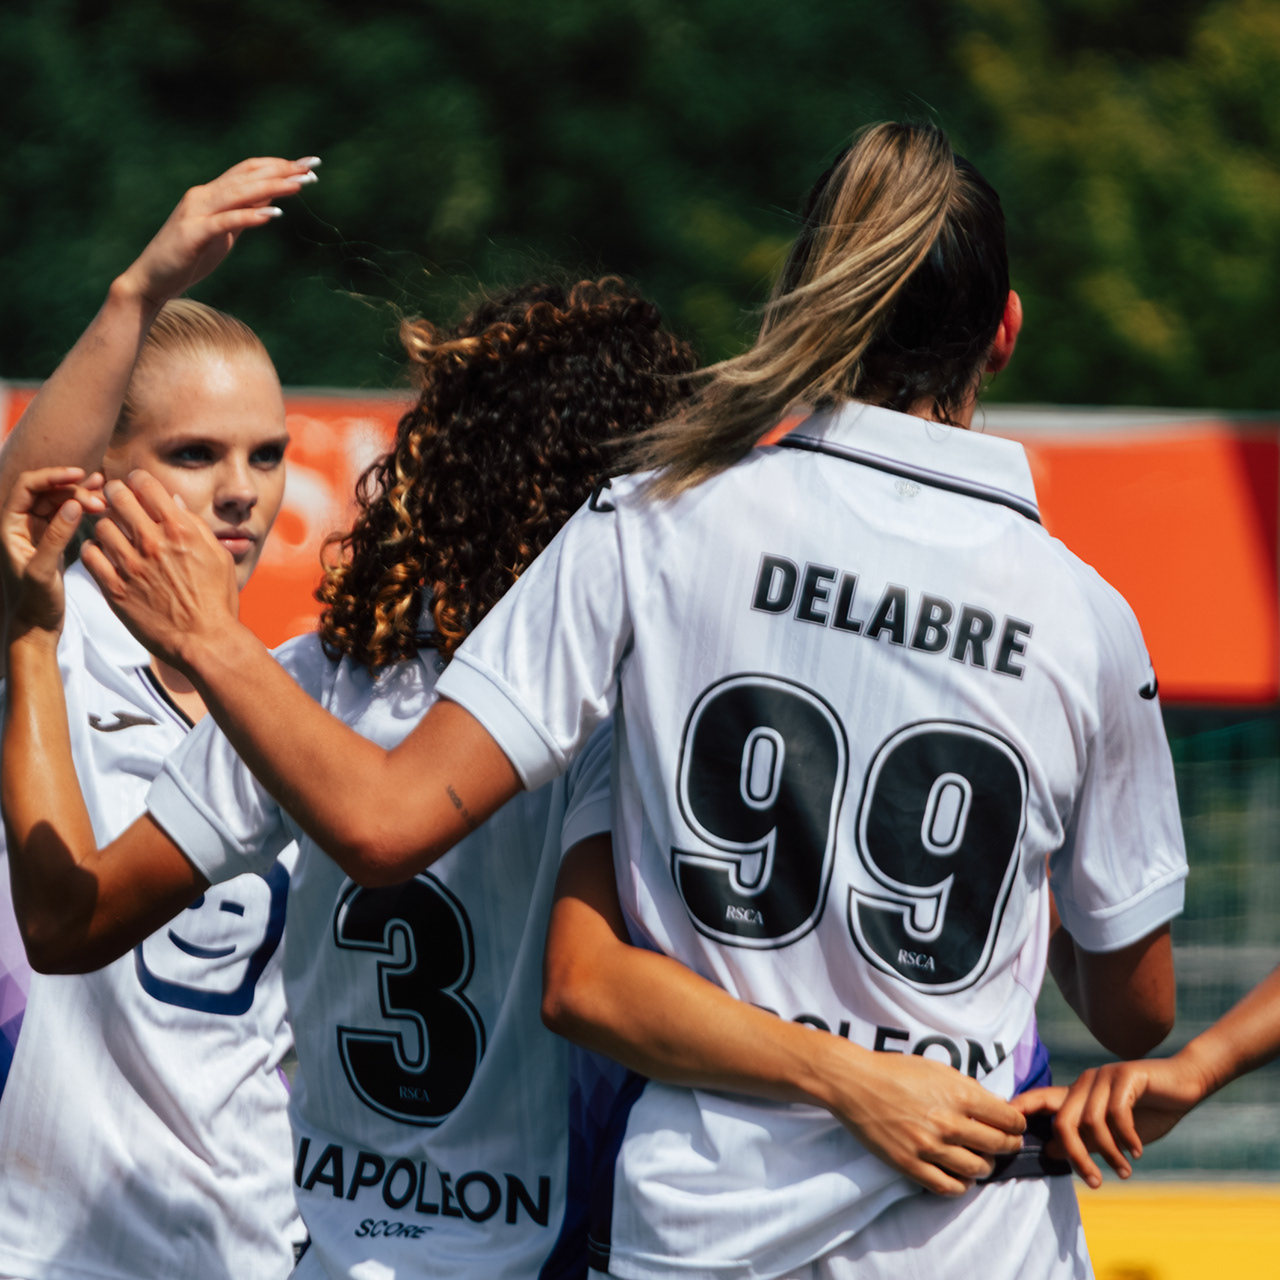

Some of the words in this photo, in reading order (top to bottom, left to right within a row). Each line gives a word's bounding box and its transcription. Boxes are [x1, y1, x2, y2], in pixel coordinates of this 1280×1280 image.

[750, 552, 1034, 680] DELABRE
[671, 671, 1029, 996] 99
[726, 905, 764, 925] RSCA
[898, 949, 935, 972] RSCA
[333, 868, 486, 1128] 3
[399, 1085, 430, 1102] RSCA
[355, 1218, 434, 1239] SCORE
